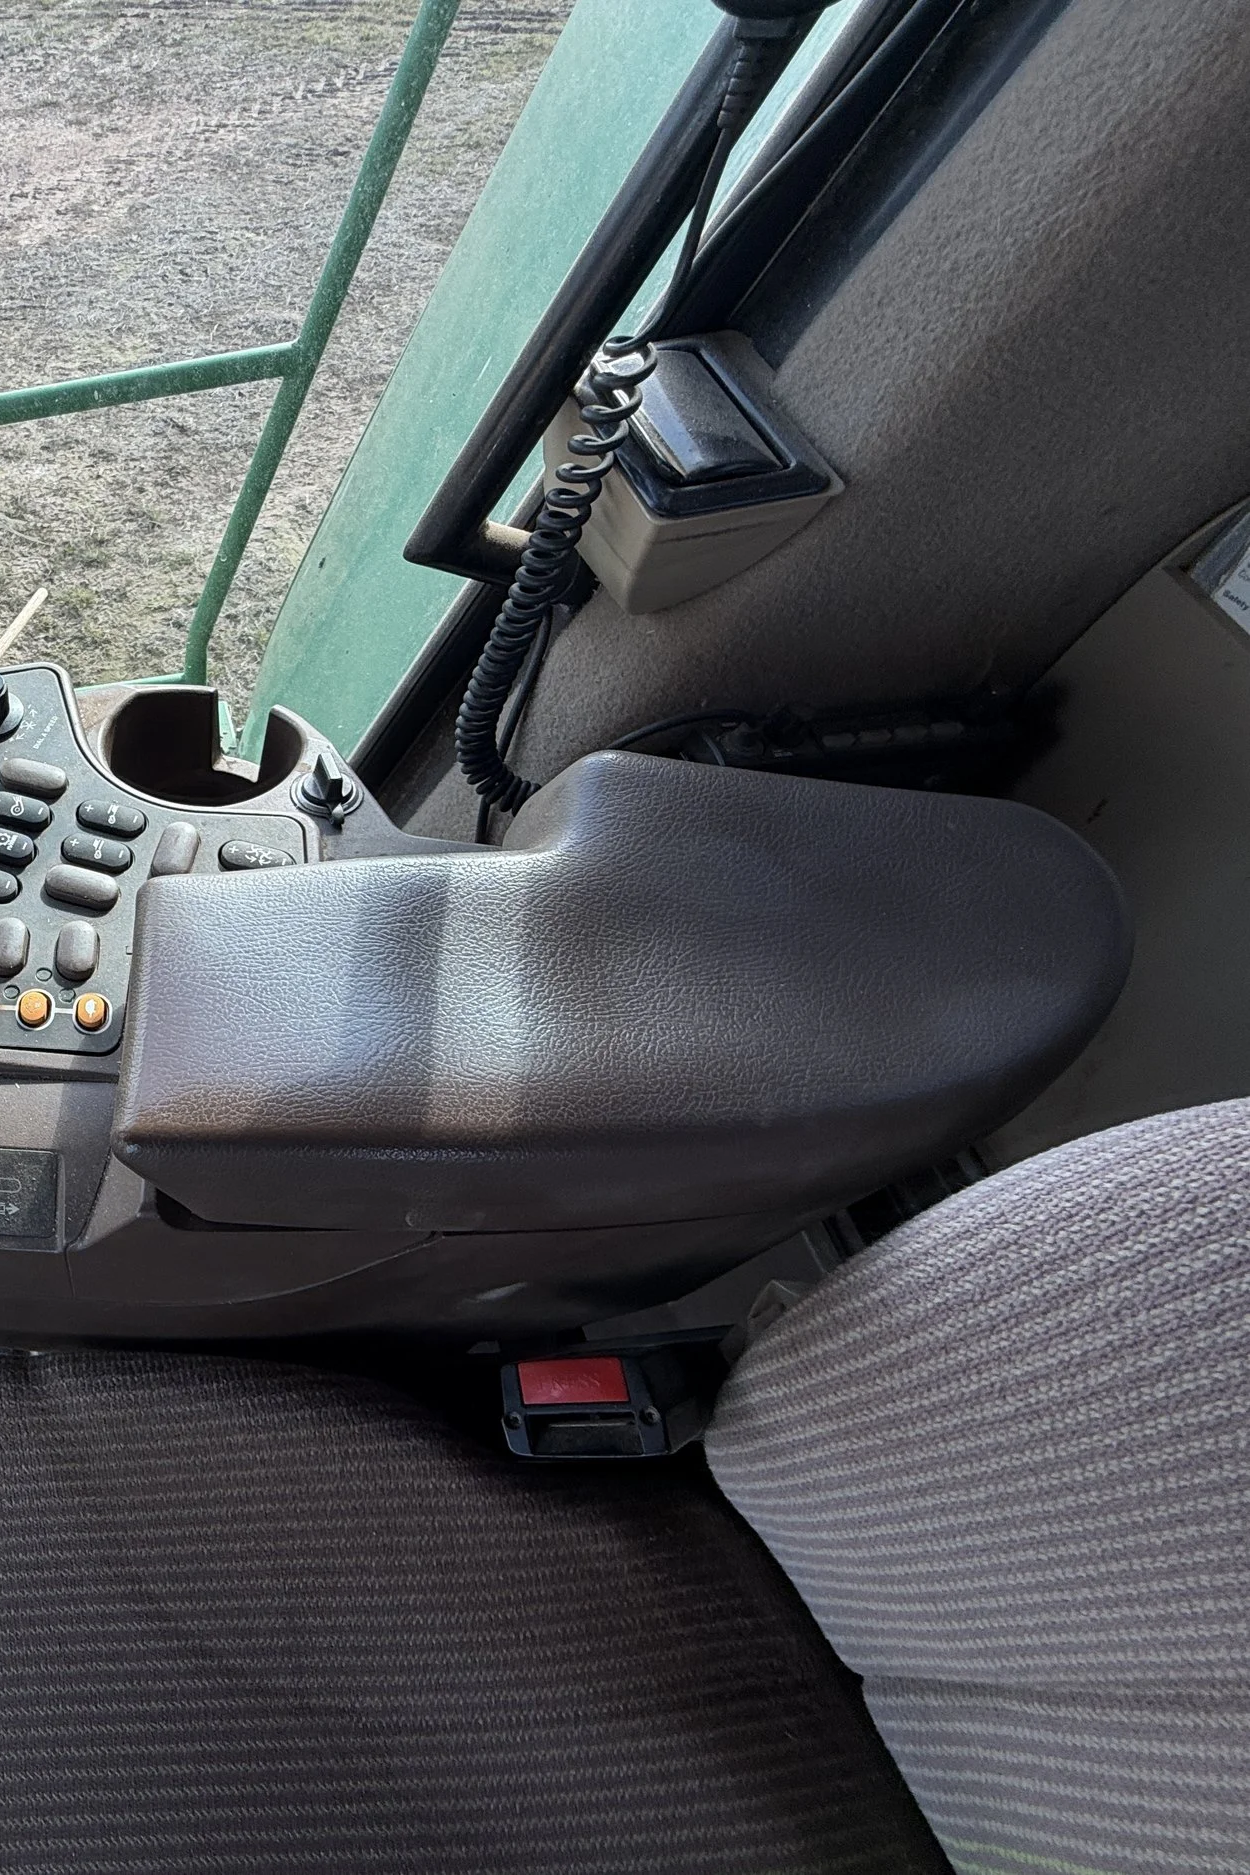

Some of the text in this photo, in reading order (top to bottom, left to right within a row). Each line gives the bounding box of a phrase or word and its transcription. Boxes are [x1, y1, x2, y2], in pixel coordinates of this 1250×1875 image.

[1222, 589, 1250, 611] Safety
[32, 737, 45, 750] DIAL
[536, 1372, 601, 1393] PRESS
